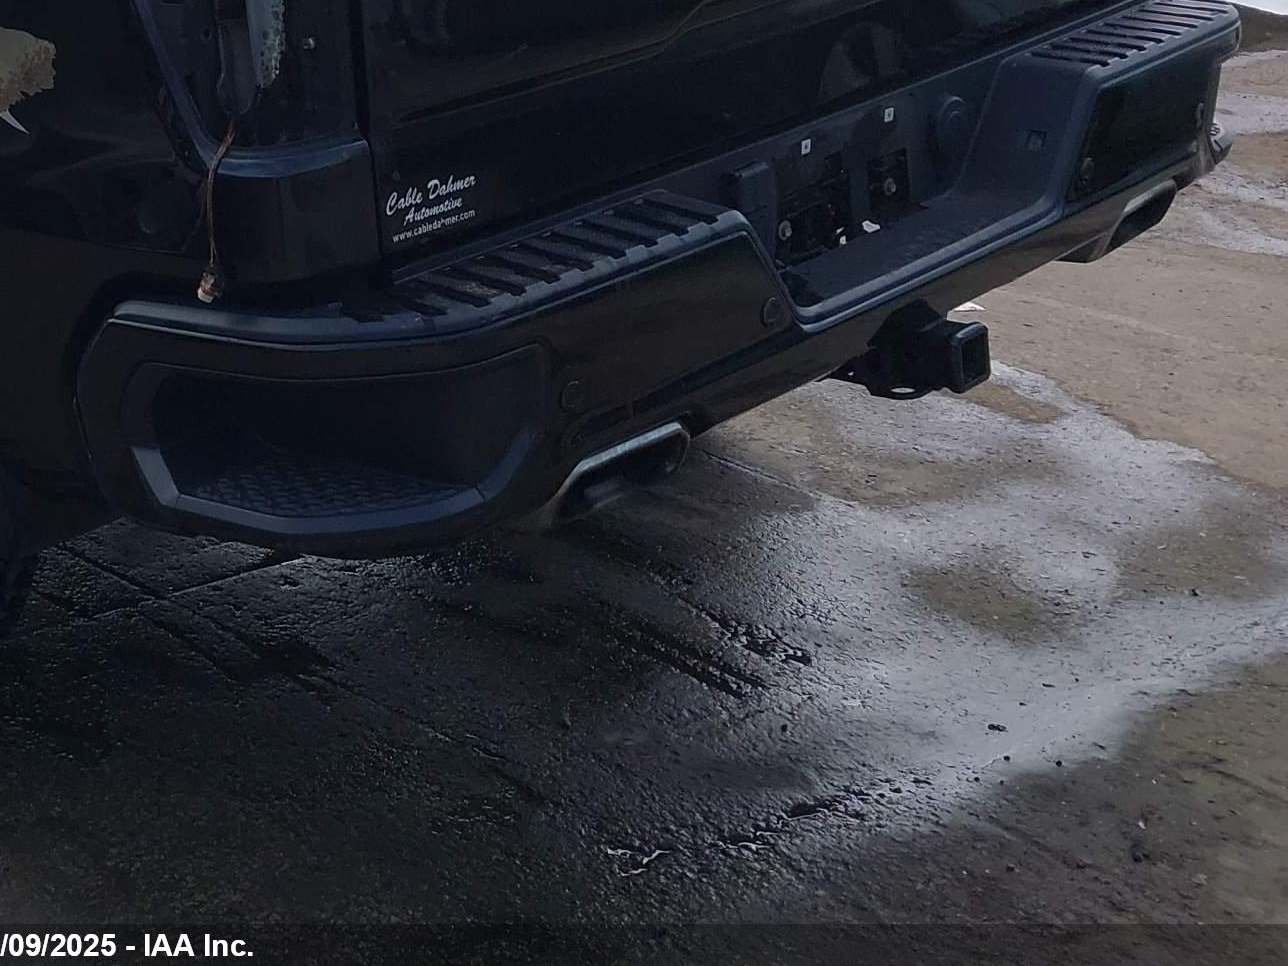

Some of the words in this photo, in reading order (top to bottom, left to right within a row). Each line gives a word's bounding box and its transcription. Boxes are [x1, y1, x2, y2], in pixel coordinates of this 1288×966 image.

[386, 187, 423, 216] Cable
[427, 175, 477, 200] Dahmer
[403, 198, 464, 226] Automotive
